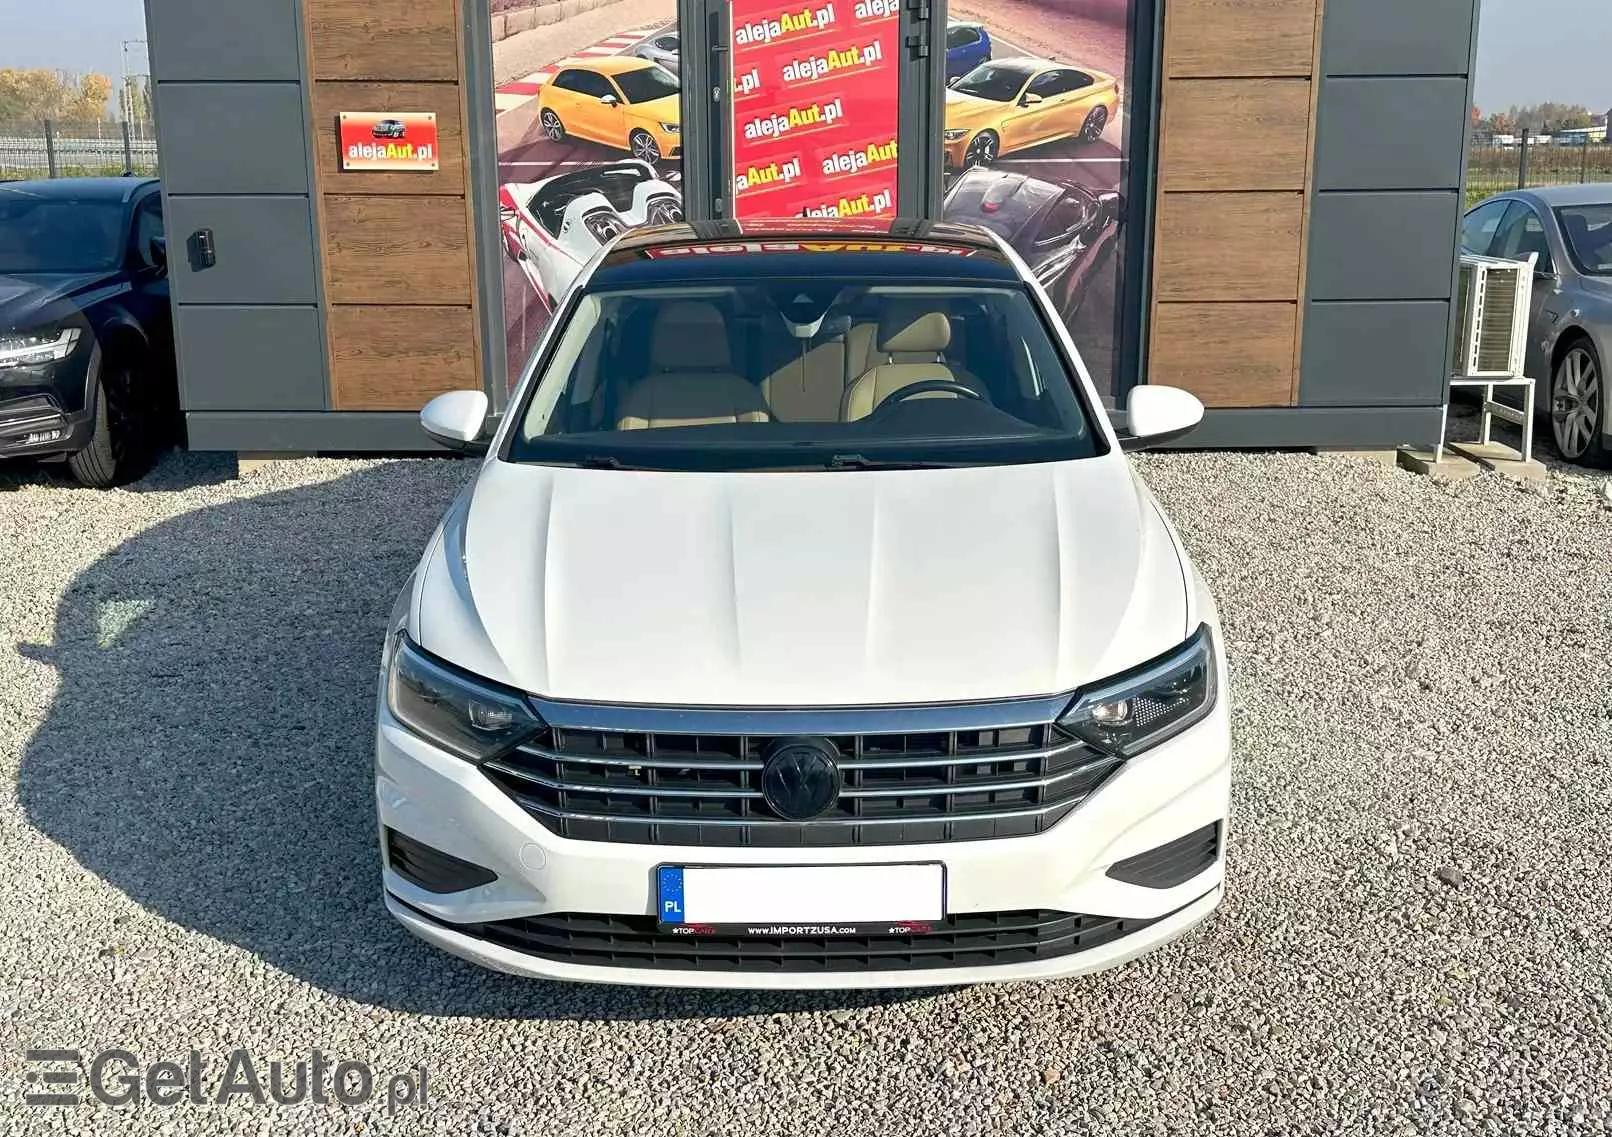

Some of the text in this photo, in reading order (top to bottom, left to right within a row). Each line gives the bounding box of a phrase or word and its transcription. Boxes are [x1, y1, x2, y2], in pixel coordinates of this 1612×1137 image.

[735, 4, 835, 44] alejaAut.pl
[782, 40, 882, 81] alejaAut.pl
[744, 99, 843, 139] alejaAut.pl
[348, 142, 432, 160] alejaAut.pl
[665, 901, 681, 913] PL
